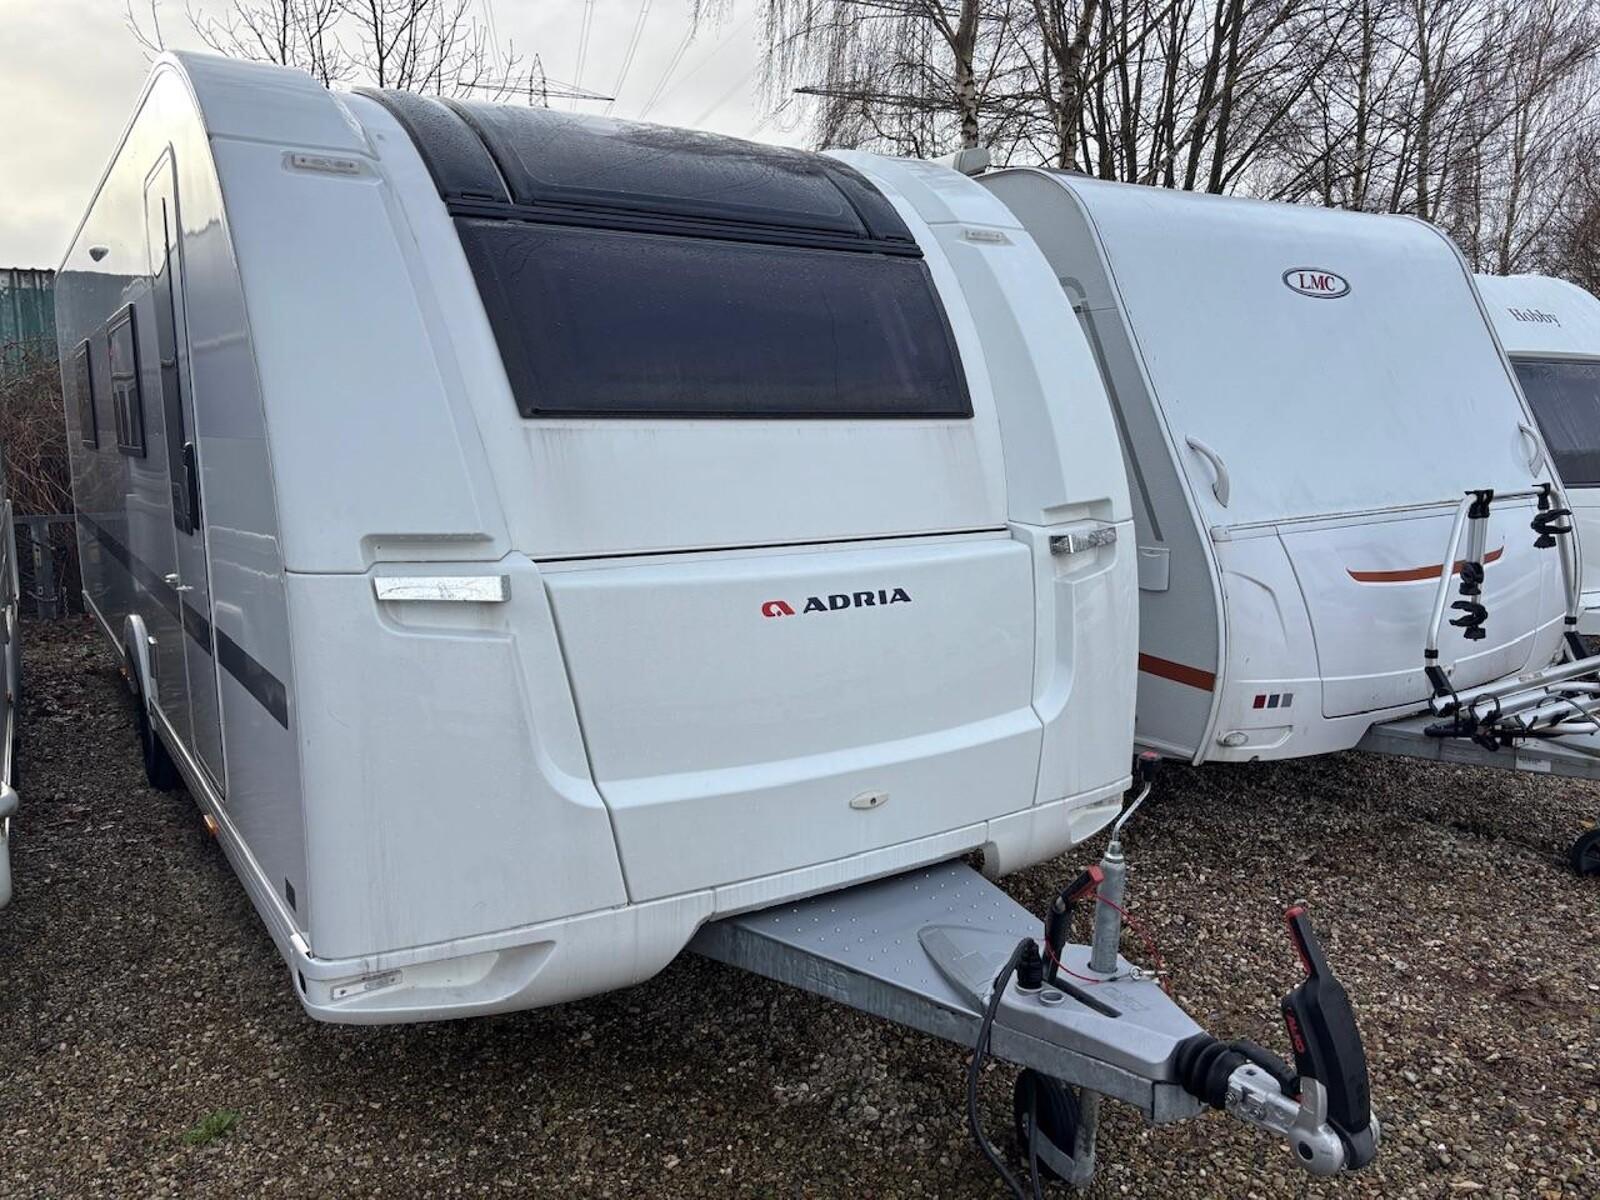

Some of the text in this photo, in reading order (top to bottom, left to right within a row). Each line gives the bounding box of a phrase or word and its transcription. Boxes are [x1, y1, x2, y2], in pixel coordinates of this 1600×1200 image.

[1298, 273, 1336, 292] LMC
[1507, 308, 1561, 328] Hobby
[803, 588, 912, 614] ADRIA
